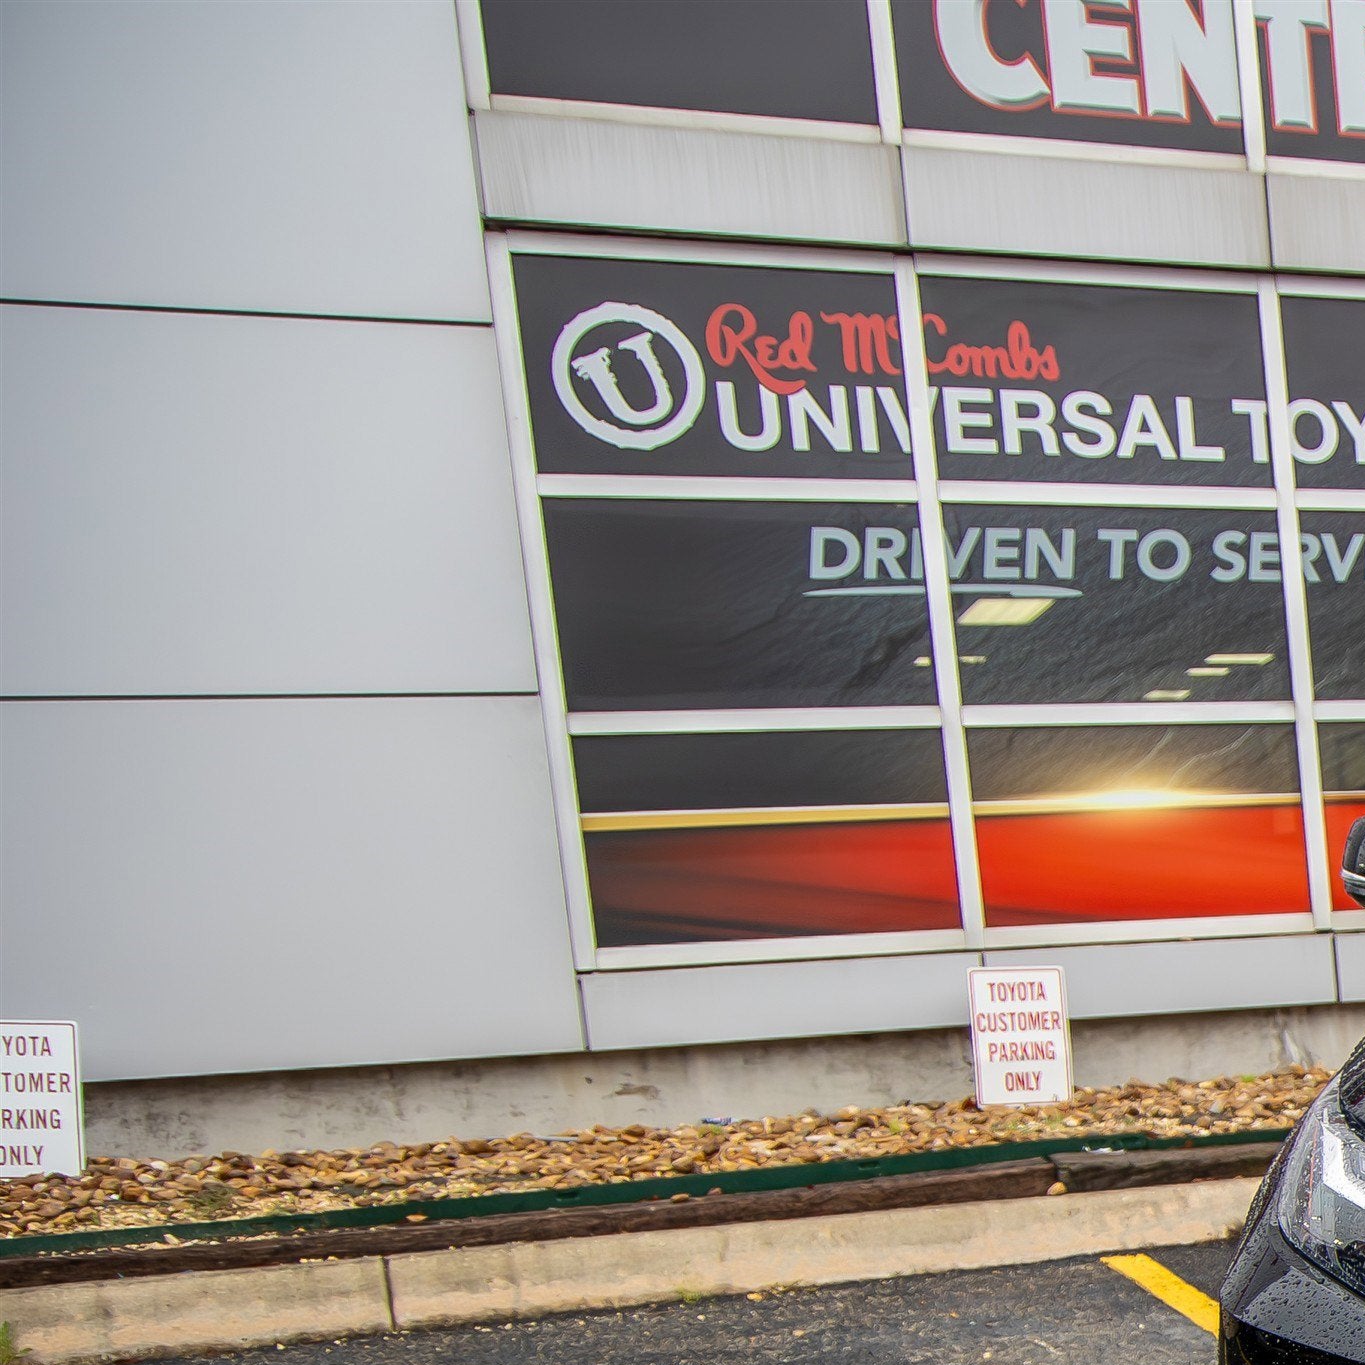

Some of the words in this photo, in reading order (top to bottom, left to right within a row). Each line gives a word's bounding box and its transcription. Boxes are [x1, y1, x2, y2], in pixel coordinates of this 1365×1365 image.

[705, 303, 818, 396] Red
[715, 380, 1227, 464] UNIVERSAL
[808, 526, 1076, 580] DRIVEN
[1097, 528, 1193, 583] TO
[987, 981, 1046, 1002] TOYOTA
[976, 1010, 1062, 1033] CUSTOMER
[1, 1035, 52, 1057] YOTA
[988, 1040, 1056, 1063] PARKING
[1, 1072, 72, 1094] TOMER
[1005, 1070, 1042, 1092] ONLY
[1, 1108, 62, 1131] RKING
